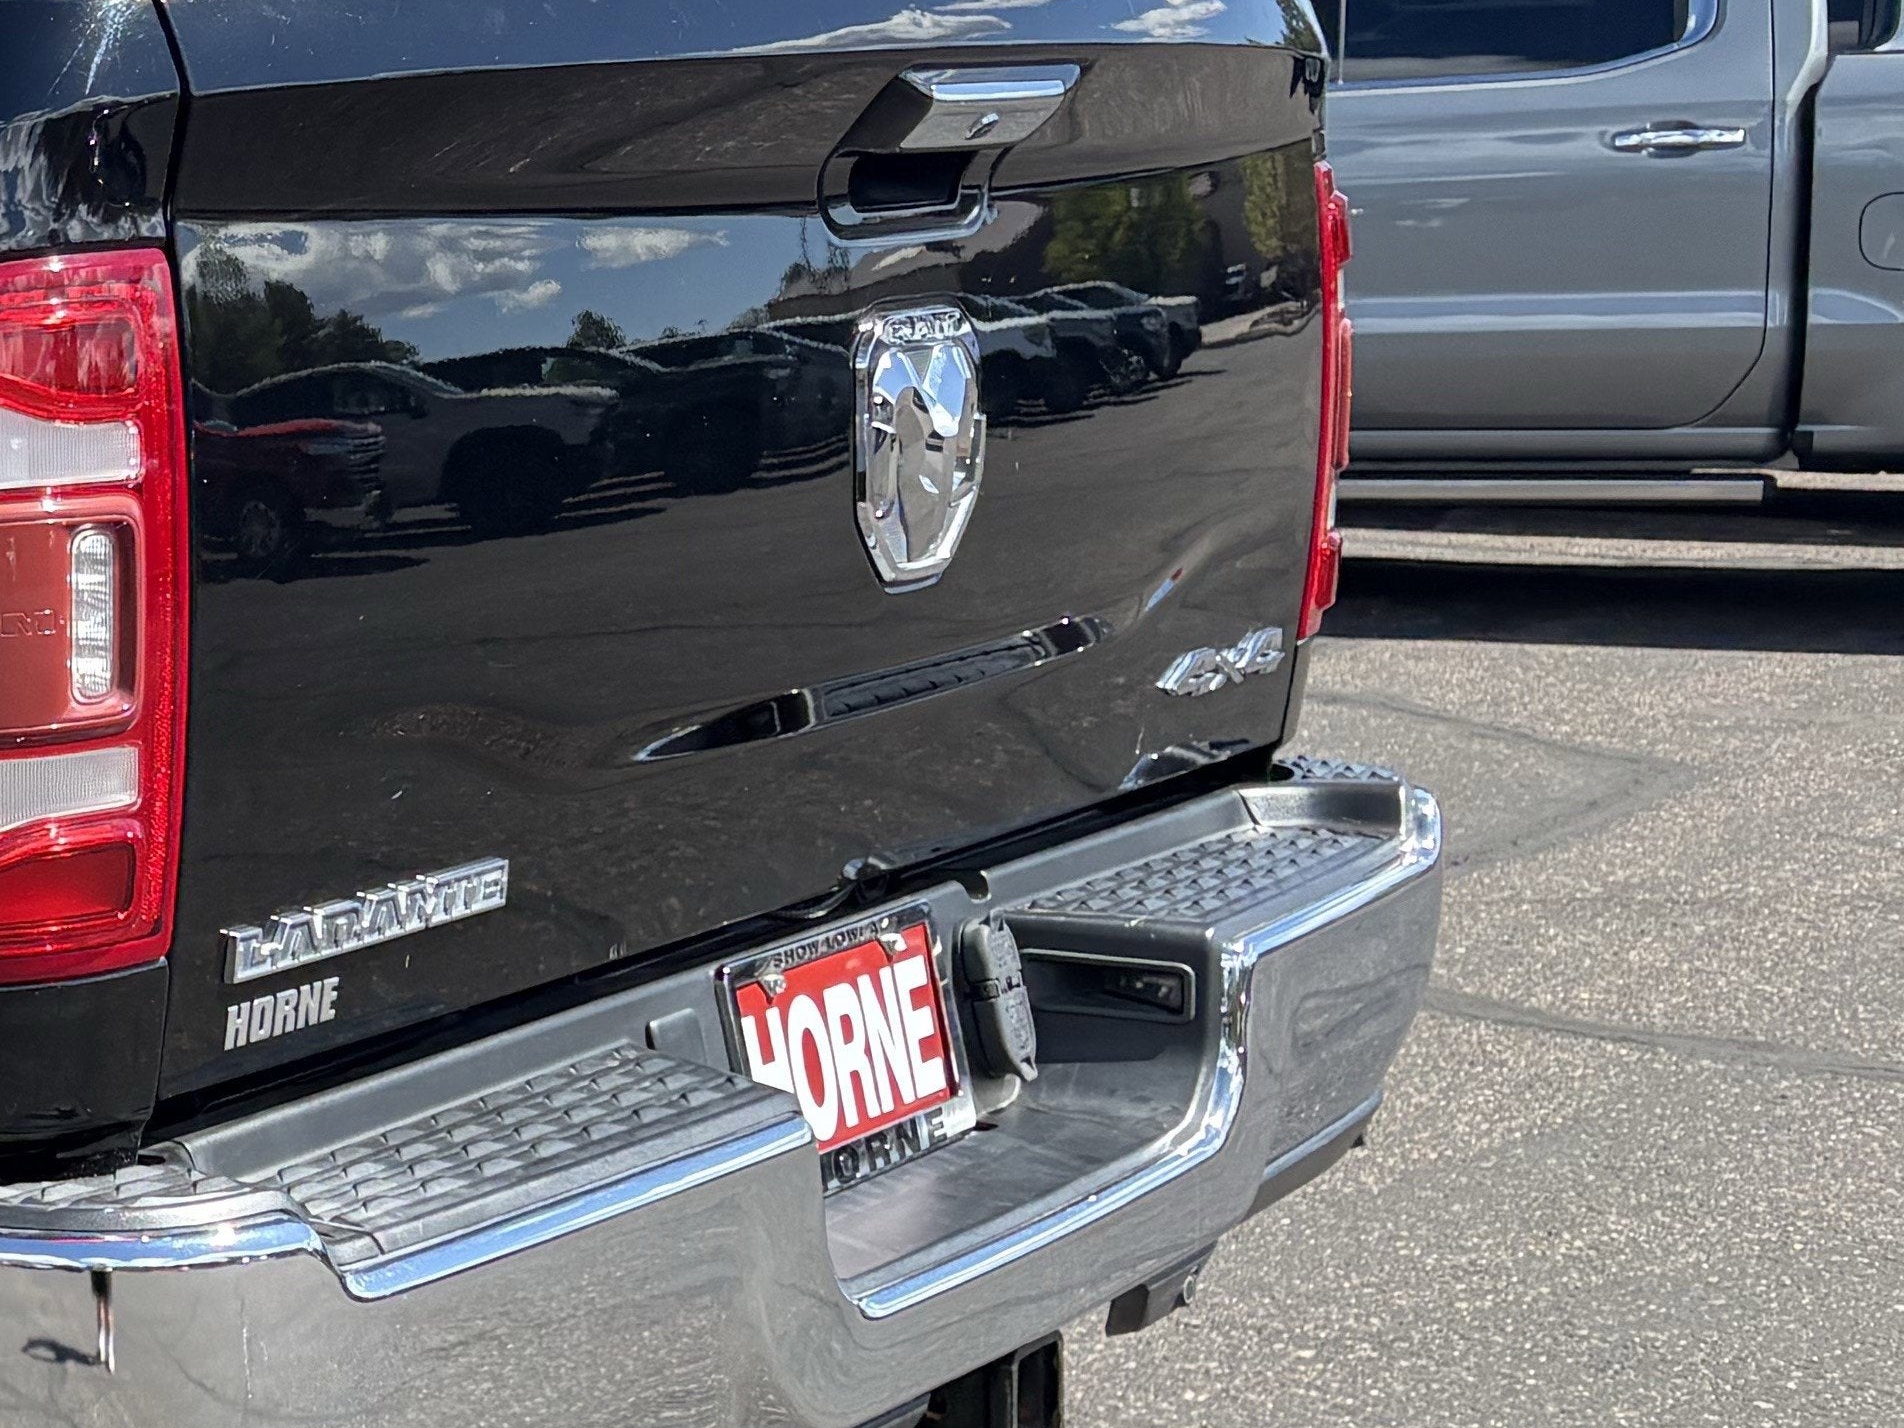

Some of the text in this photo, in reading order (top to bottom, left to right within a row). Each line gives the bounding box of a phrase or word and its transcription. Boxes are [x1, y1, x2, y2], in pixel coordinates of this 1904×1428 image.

[221, 857, 509, 984] LARAMIE
[772, 938, 821, 969] SHOW
[224, 976, 340, 1052] HORNE
[741, 954, 947, 1141] HORNE
